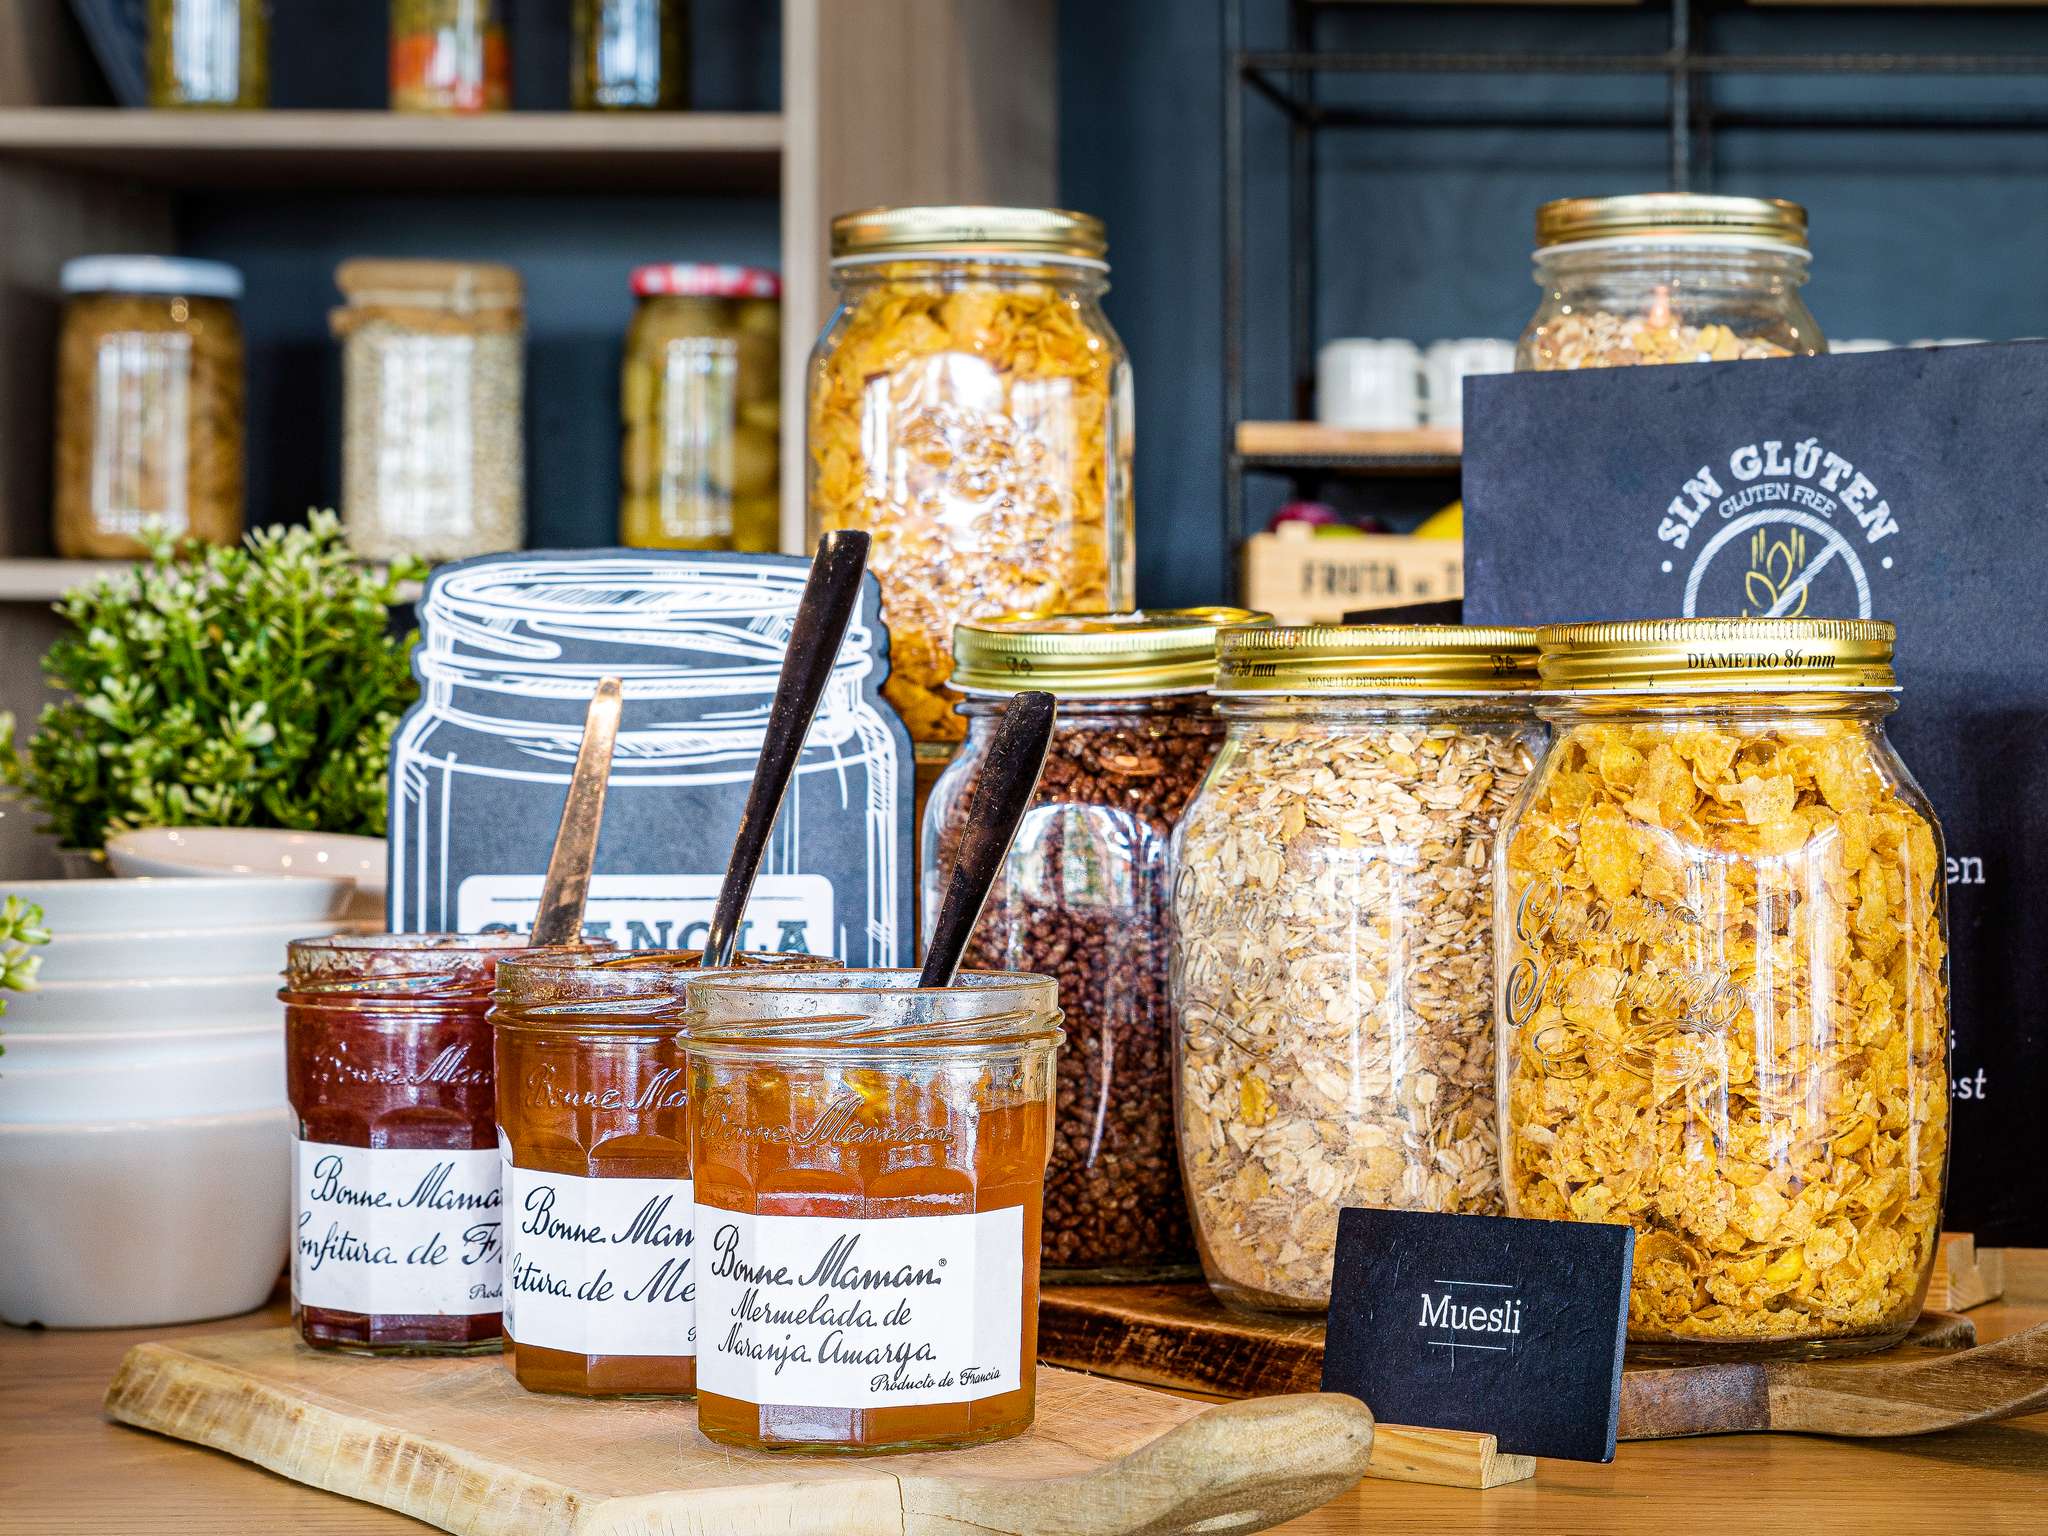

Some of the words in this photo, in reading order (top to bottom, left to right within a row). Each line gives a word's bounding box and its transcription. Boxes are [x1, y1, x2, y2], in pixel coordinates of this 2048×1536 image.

[1658, 465, 1723, 549] SIN
[1730, 437, 1899, 544] GLÚTEN
[1718, 482, 1790, 519] GLUTEN
[1791, 485, 1837, 519] FREE
[1253, 663, 1276, 677] mm
[1687, 653, 1779, 668] DIAMETRO
[1783, 649, 1803, 668] 86
[1807, 654, 1836, 669] mm
[1307, 676, 1354, 687] MODELLO
[1356, 676, 1417, 687] DEPOSITATO
[311, 1155, 392, 1208] Bonne
[398, 1162, 503, 1210] Mama
[522, 1186, 606, 1244] Bonne
[407, 1232, 448, 1266] de
[711, 1224, 793, 1286] Bonne
[577, 1269, 614, 1301] de
[624, 1257, 696, 1304] Me
[731, 1288, 878, 1328] Mermelada
[883, 1298, 912, 1327] de
[1418, 1293, 1521, 1334] Muesli
[718, 1322, 812, 1376] Naranja
[817, 1330, 937, 1382] Amarga
[870, 1373, 936, 1392] Producto
[938, 1371, 954, 1388] de
[960, 1366, 1001, 1386] Francia
